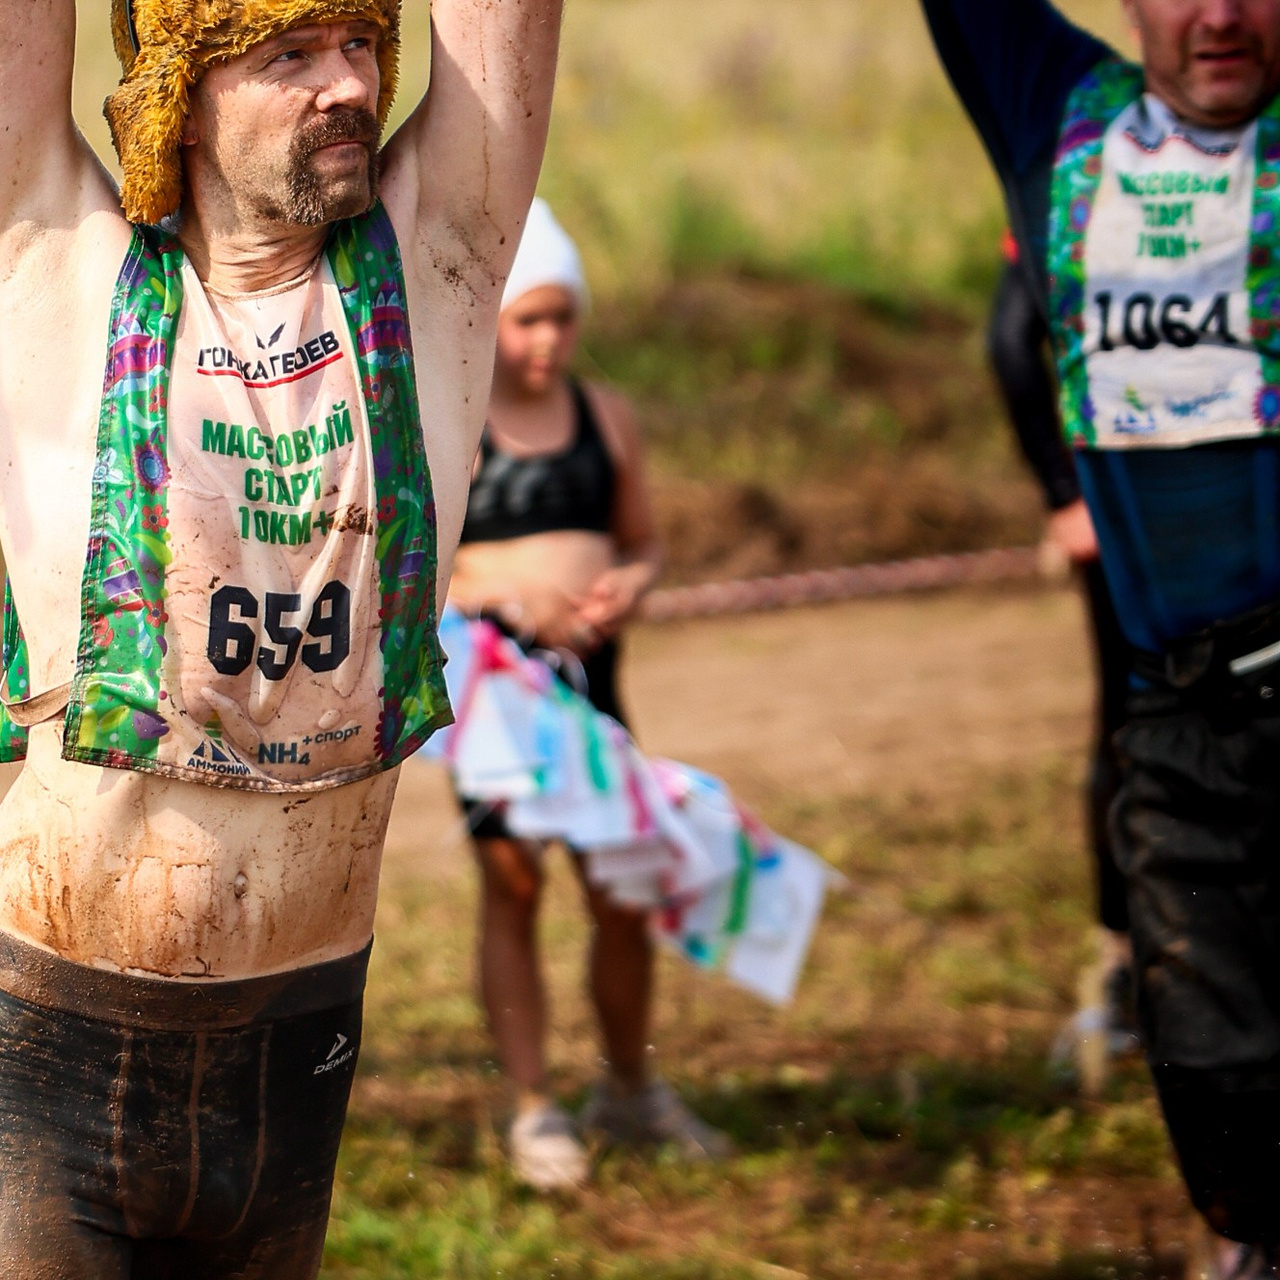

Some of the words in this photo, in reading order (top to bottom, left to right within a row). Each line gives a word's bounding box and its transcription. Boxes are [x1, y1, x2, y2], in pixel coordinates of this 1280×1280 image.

[1094, 291, 1238, 351] 1064
[197, 346, 269, 381] ГОНКА
[268, 330, 340, 378] ГЕОЕВ
[201, 400, 355, 468] МАССОВЫЙ
[244, 466, 323, 507] СТАРТ
[207, 578, 351, 681] 659
[313, 1047, 355, 1075] DEMIX
